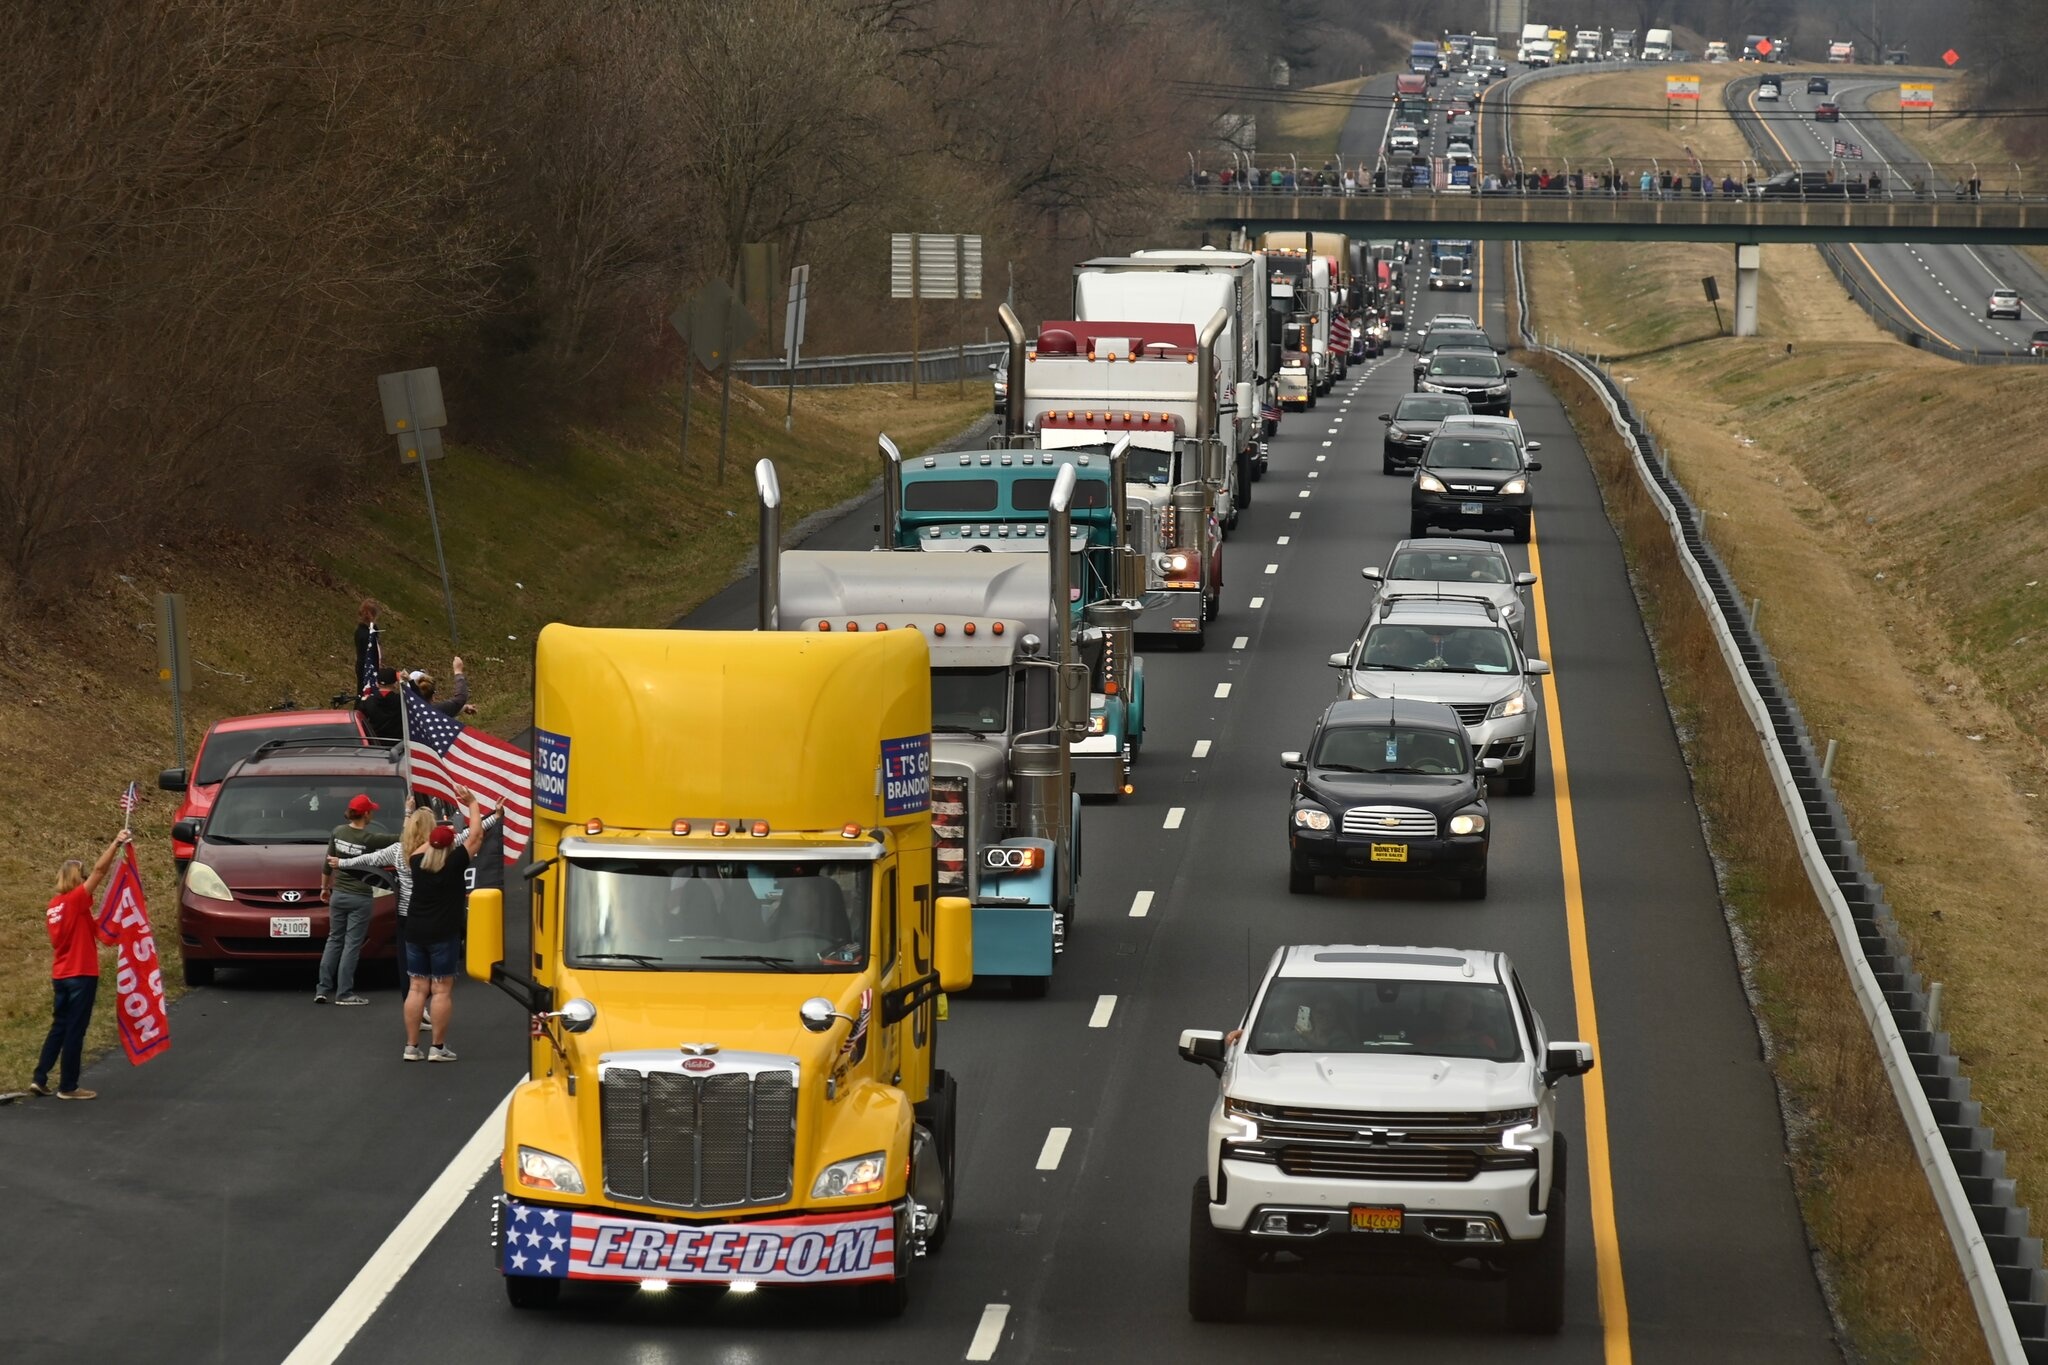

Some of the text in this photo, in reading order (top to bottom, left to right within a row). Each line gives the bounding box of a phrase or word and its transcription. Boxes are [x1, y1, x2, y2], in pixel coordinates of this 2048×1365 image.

[549, 751, 566, 774] GO
[885, 751, 930, 778] LET'S GO
[887, 776, 930, 800] BRANDON
[587, 1224, 879, 1276] FREEDOM
